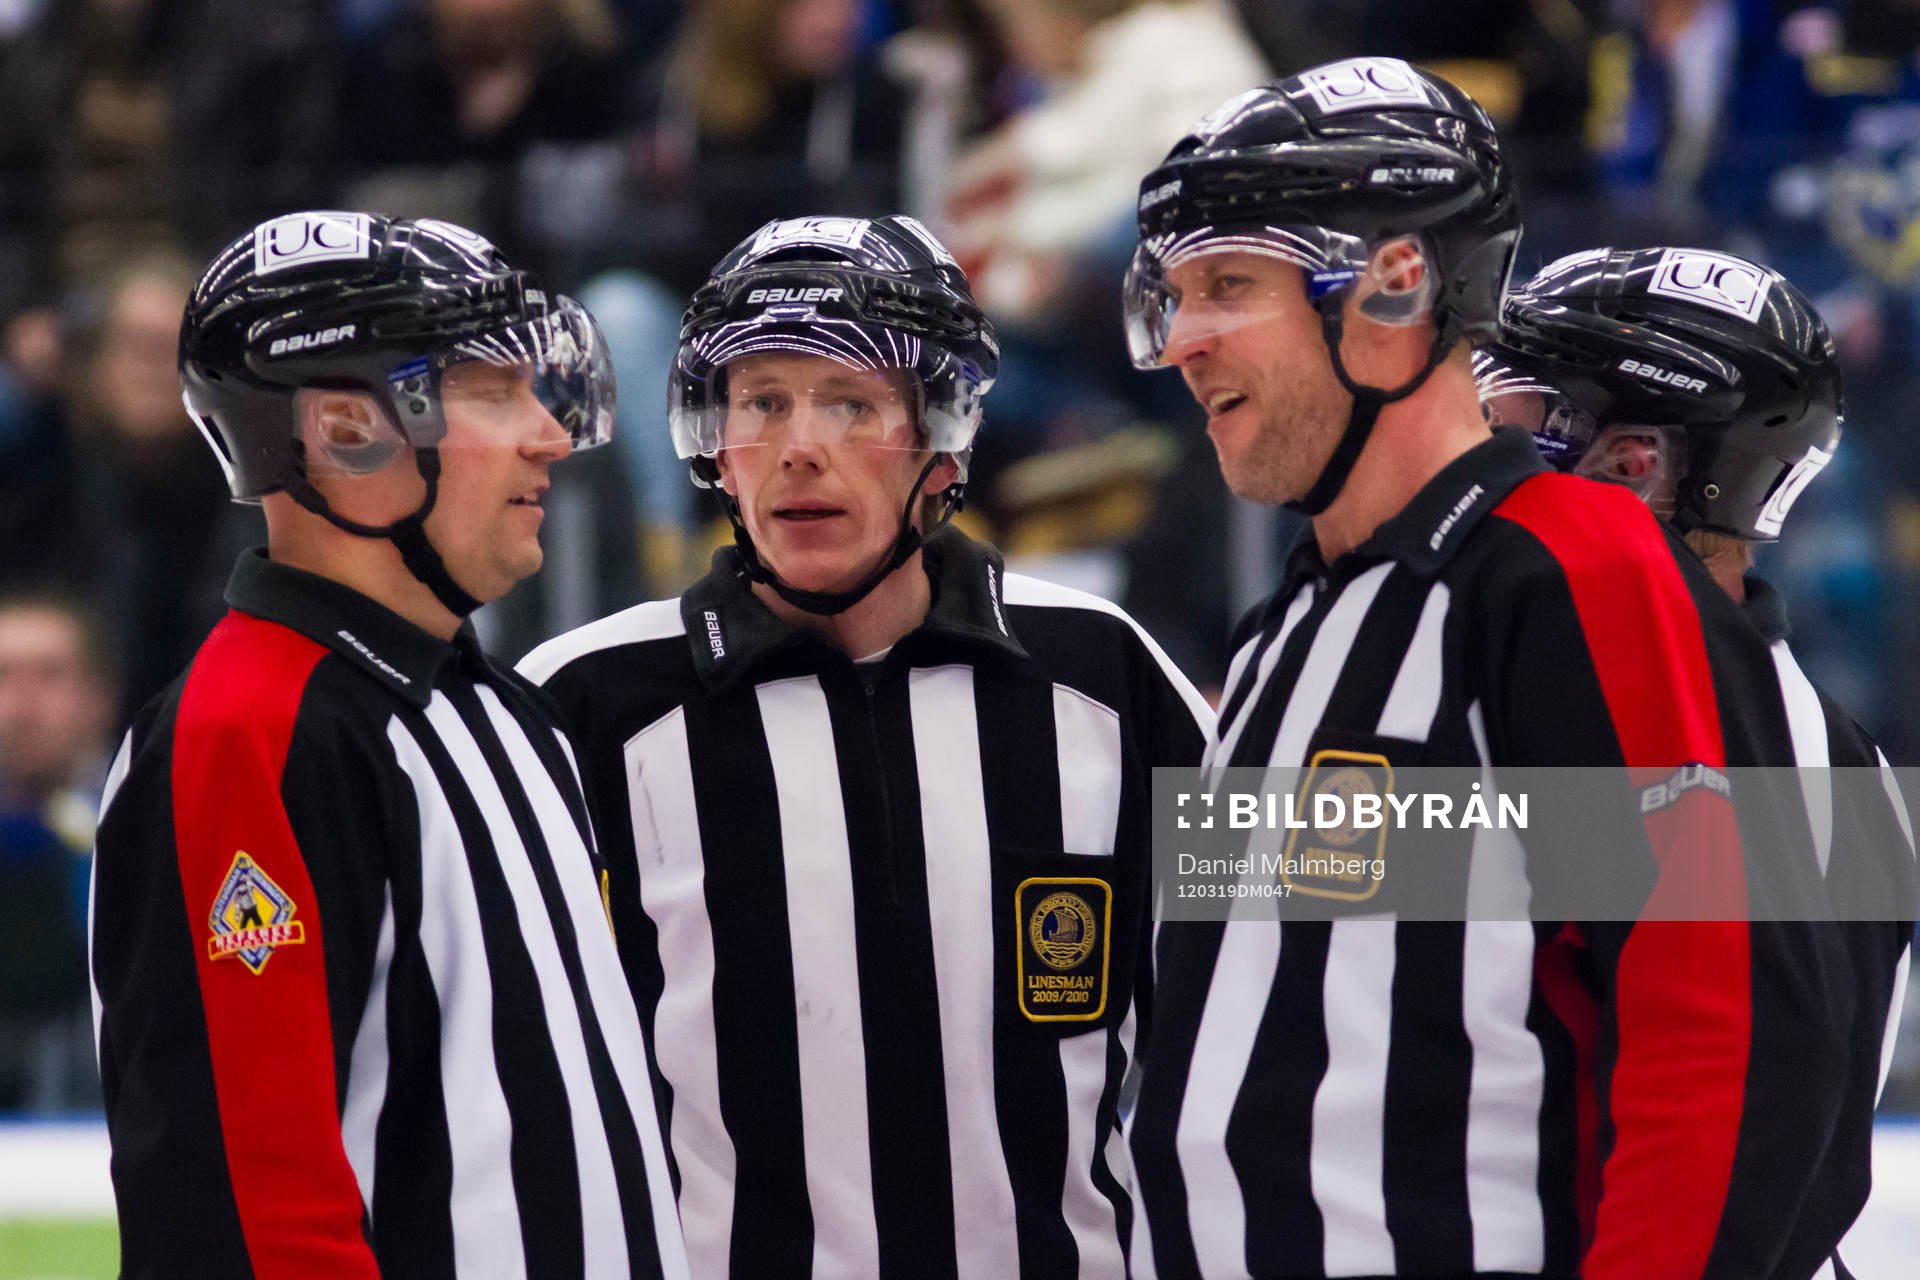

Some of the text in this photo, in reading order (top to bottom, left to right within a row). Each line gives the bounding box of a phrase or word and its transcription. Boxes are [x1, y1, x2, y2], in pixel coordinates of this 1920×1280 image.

[269, 220, 350, 257] UC
[746, 287, 844, 304] BAUER
[1669, 256, 1756, 304] UC
[269, 323, 357, 356] BAUER
[1617, 358, 1709, 394] BAUER
[1429, 484, 1485, 551] BAUER
[704, 610, 726, 660] BAUER
[337, 630, 411, 684] BAUER
[1028, 975, 1094, 989] LINESMAN
[1032, 990, 1089, 1003] 2009/2010
